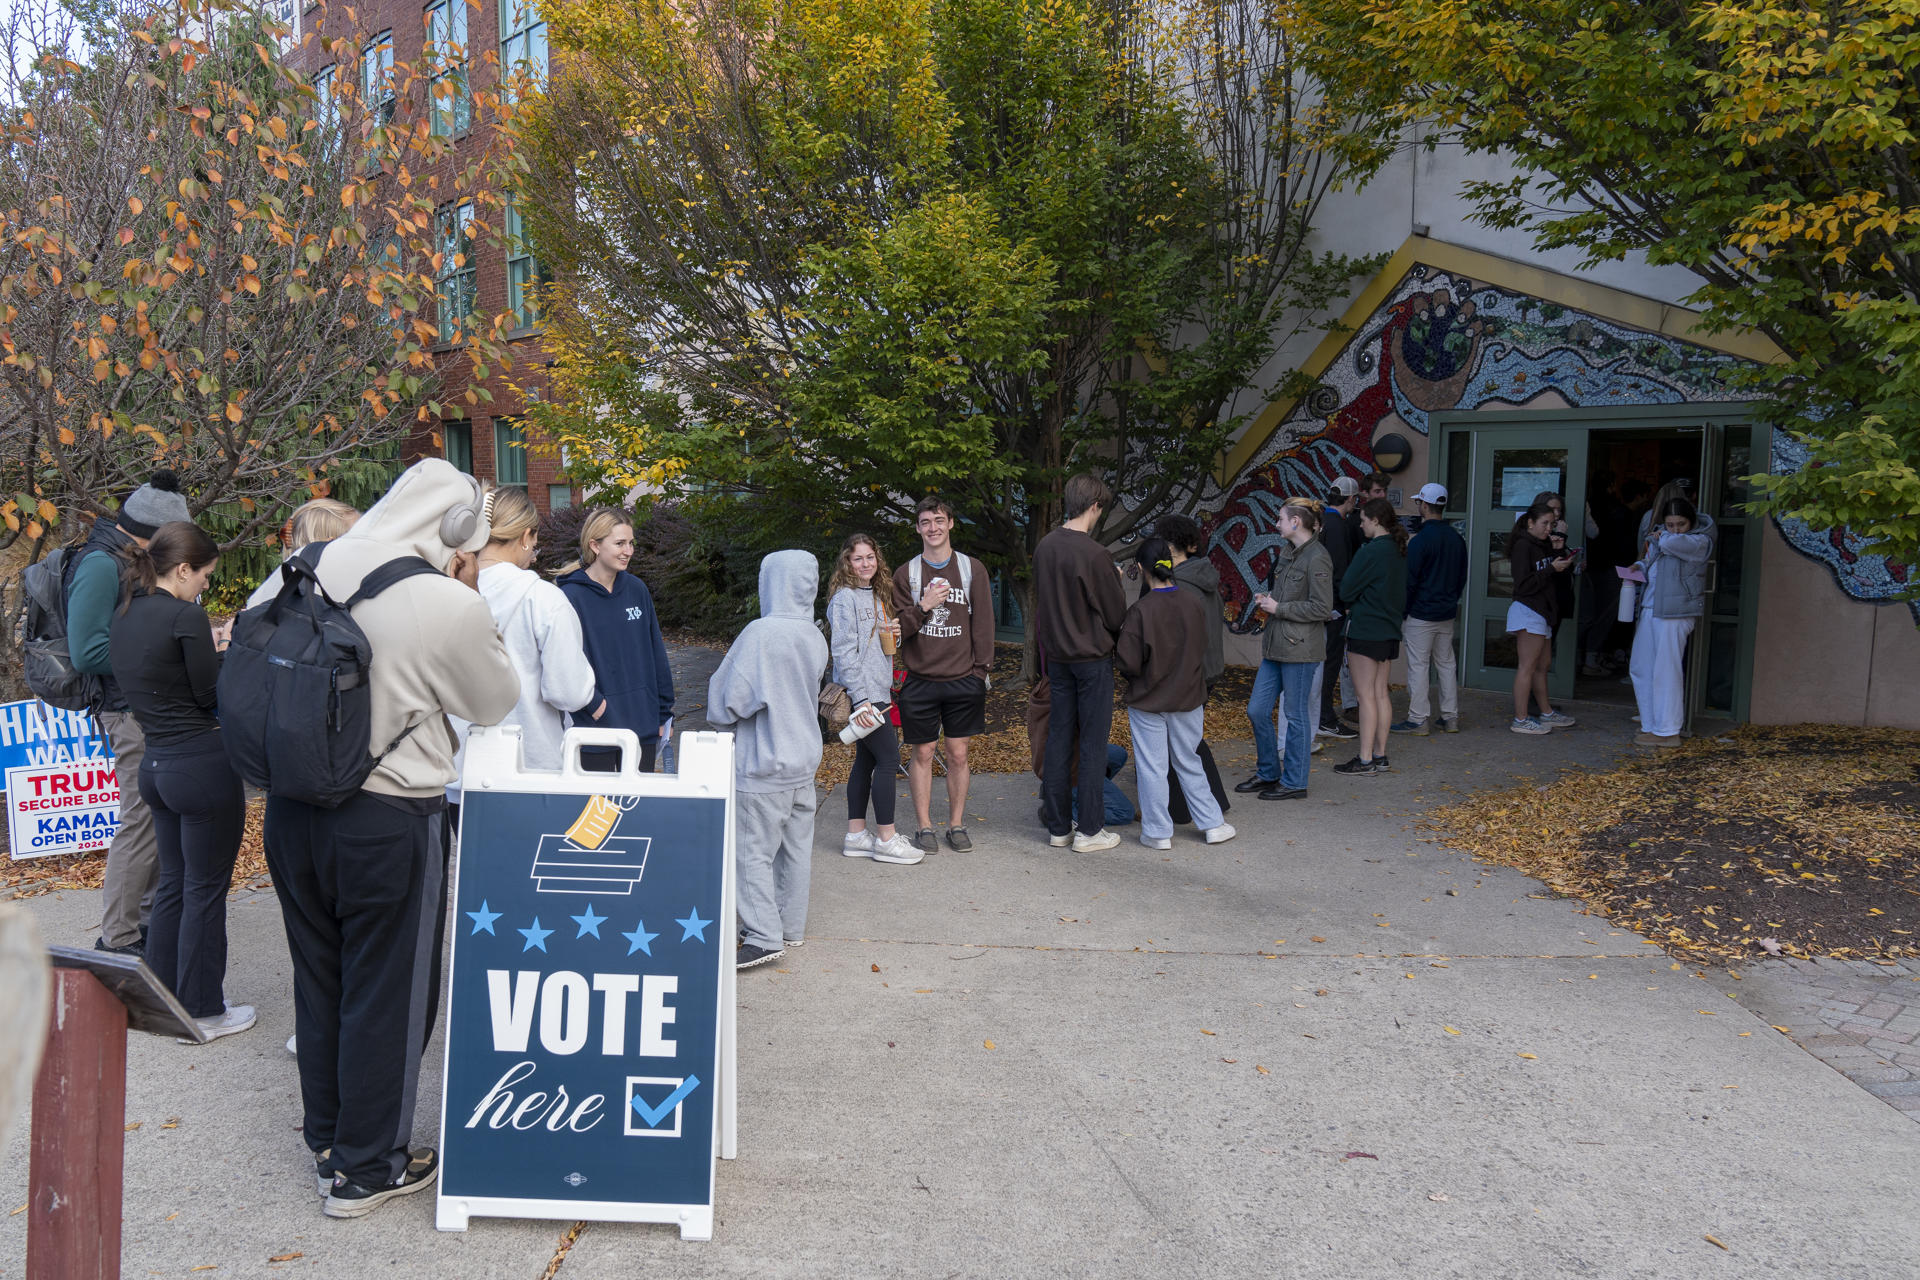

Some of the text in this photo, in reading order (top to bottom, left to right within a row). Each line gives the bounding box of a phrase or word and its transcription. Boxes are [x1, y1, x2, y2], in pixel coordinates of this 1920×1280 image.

[918, 625, 962, 638] ATHLETICS
[25, 740, 104, 767] WALZ
[27, 768, 120, 797] TRUM
[18, 791, 120, 812] SECURE BOR
[37, 811, 121, 834] KAMAL
[31, 827, 116, 847] OPEN BOR
[77, 840, 104, 850] 2024
[486, 969, 679, 1058] VOTE
[464, 1060, 605, 1133] here
